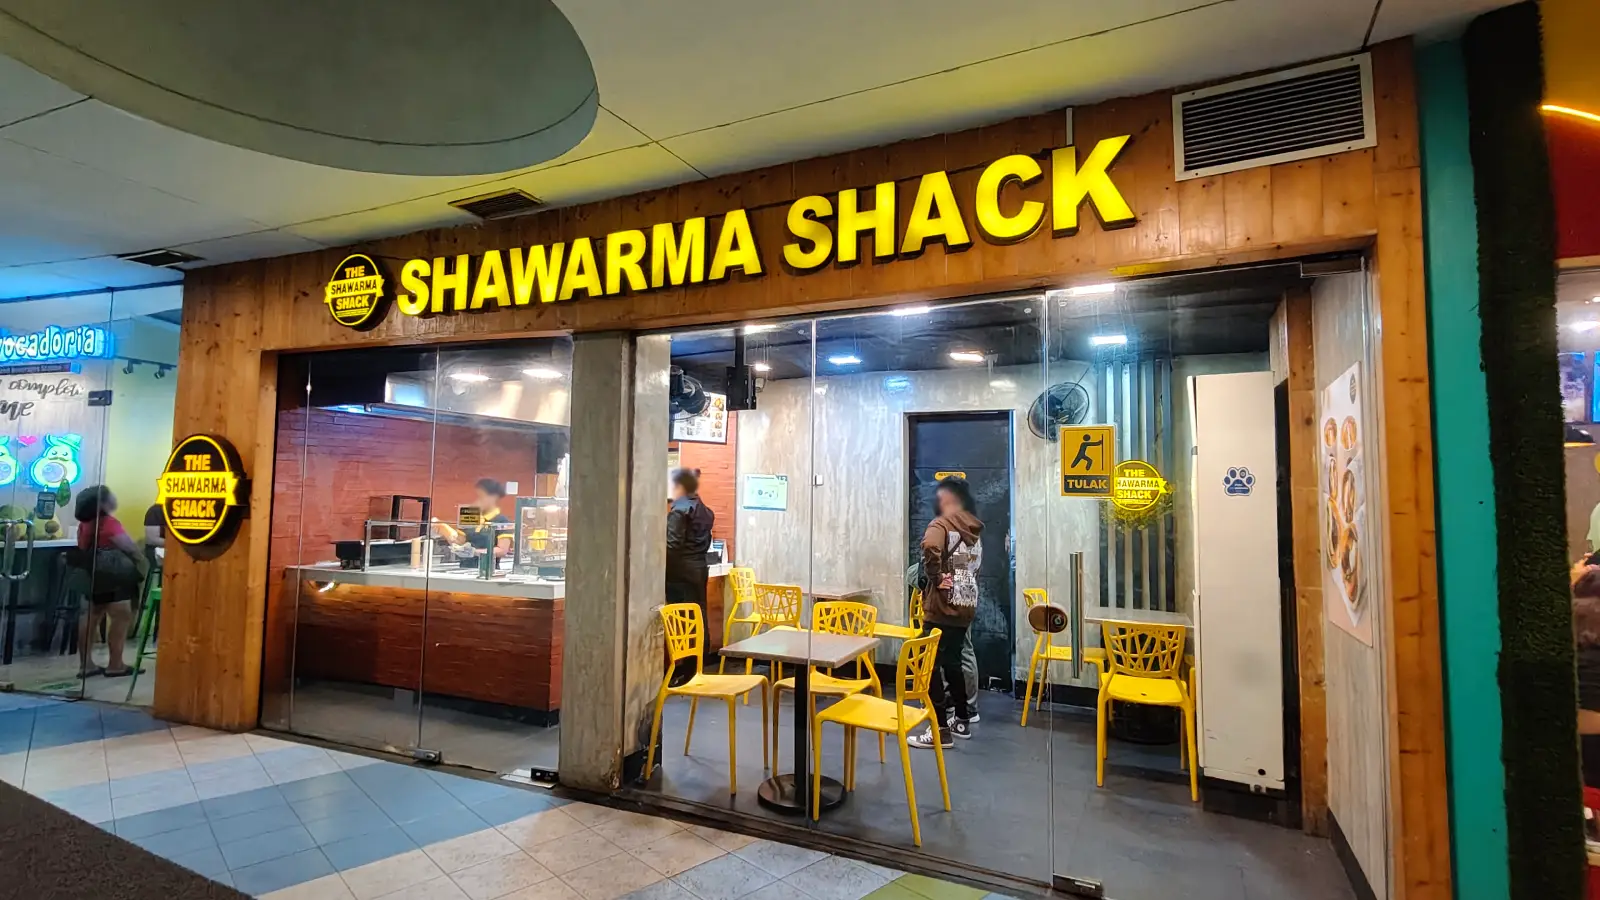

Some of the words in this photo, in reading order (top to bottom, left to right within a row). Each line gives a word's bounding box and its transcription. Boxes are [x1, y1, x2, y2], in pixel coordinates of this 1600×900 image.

[397, 209, 762, 316] SHAWARMA
[783, 134, 1136, 270] SHACK
[344, 265, 365, 279] THE
[331, 279, 377, 295] SHAWARMA
[336, 295, 370, 310] SHACK
[183, 454, 211, 471] THE
[1123, 469, 1146, 477] THE
[165, 477, 227, 493] SHAWARMA
[1066, 479, 1108, 489] TULAK
[1115, 479, 1160, 488] HAWARMA
[1116, 490, 1152, 499] SHACK
[172, 499, 216, 518] SHACK
